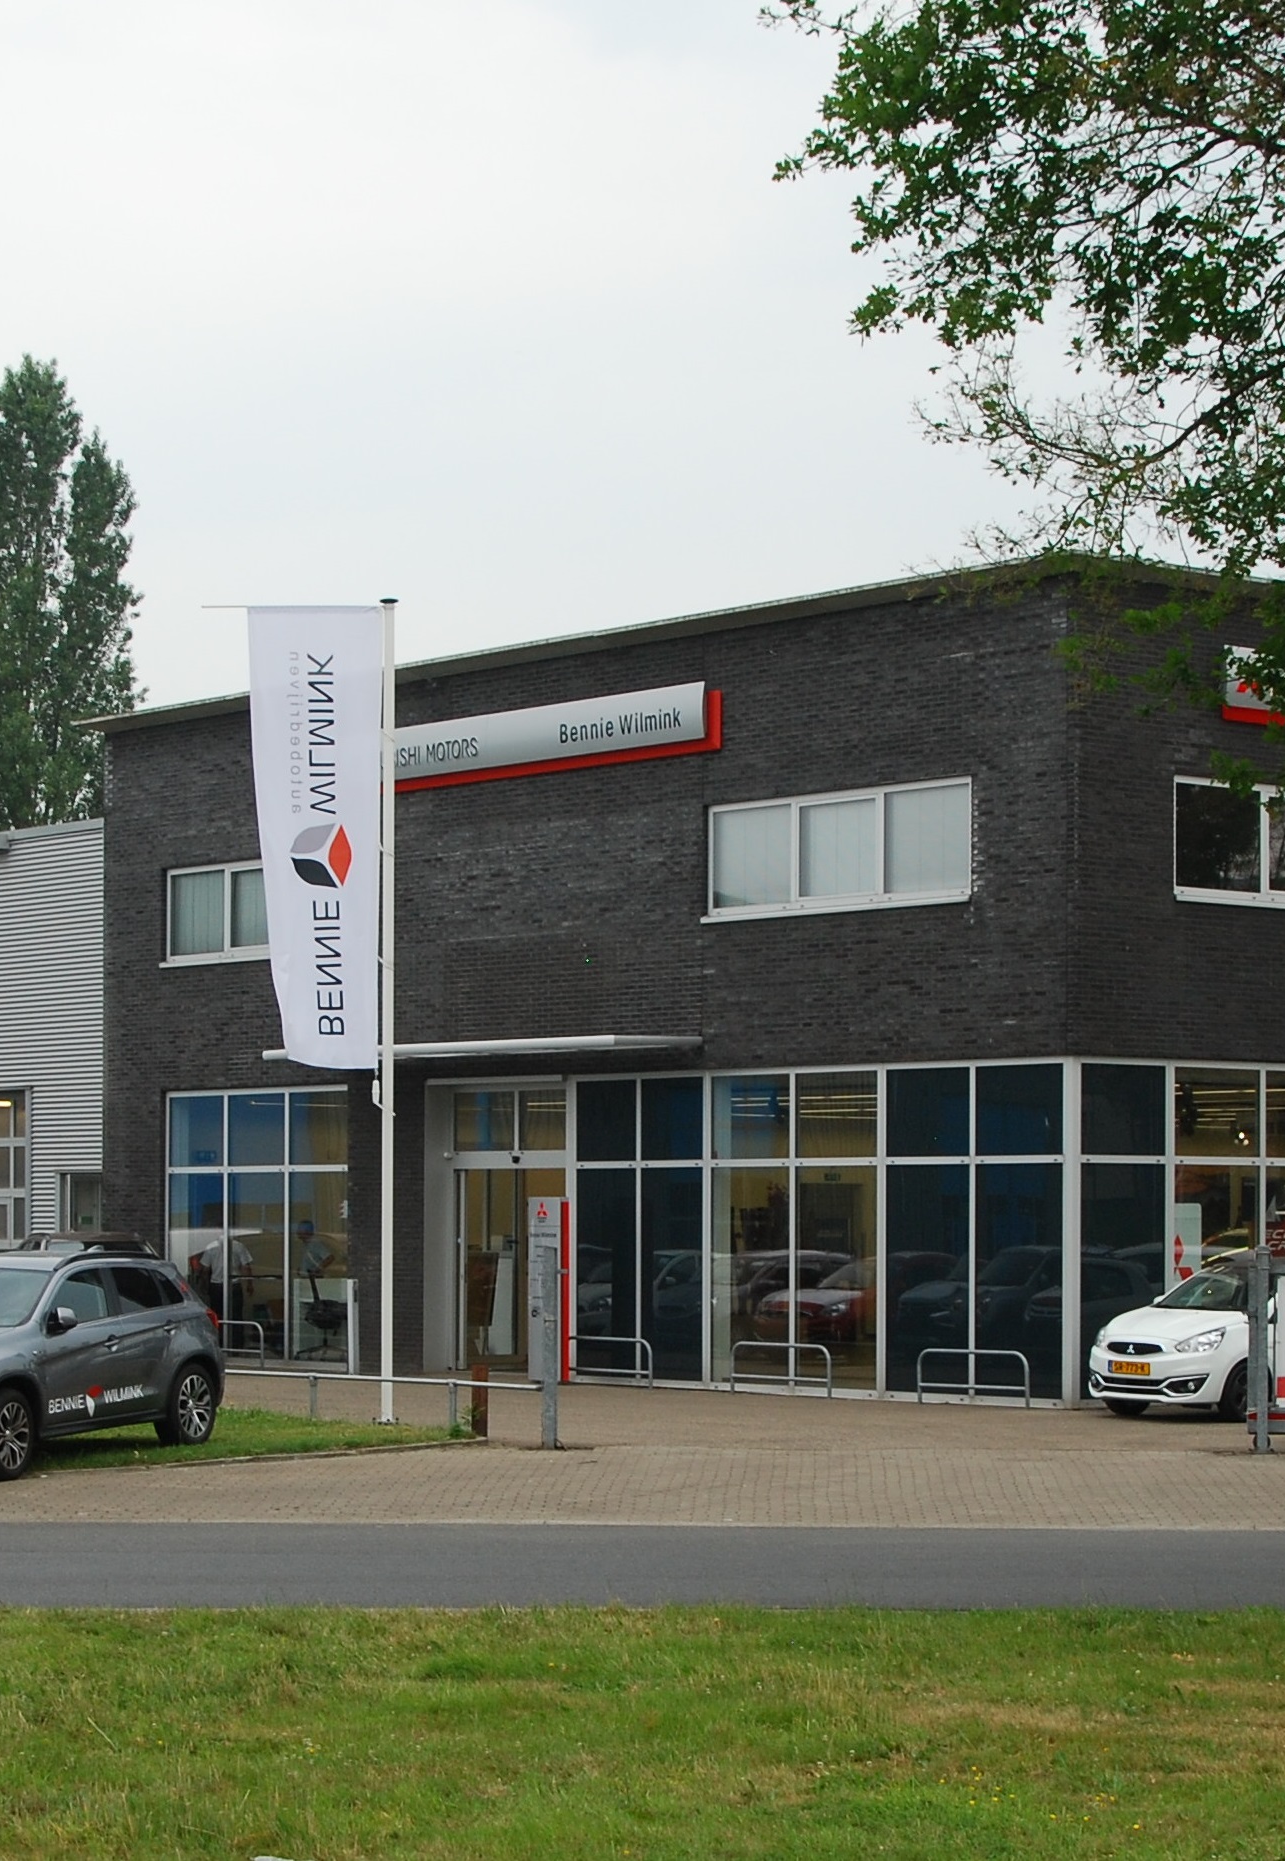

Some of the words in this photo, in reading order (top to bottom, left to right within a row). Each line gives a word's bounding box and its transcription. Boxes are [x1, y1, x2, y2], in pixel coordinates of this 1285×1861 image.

[559, 716, 614, 744] Bennie
[619, 707, 682, 736] Wilmink
[425, 736, 479, 762] MOTORS
[47, 1394, 86, 1414] BENNIE
[103, 1384, 145, 1404] WILMINK
